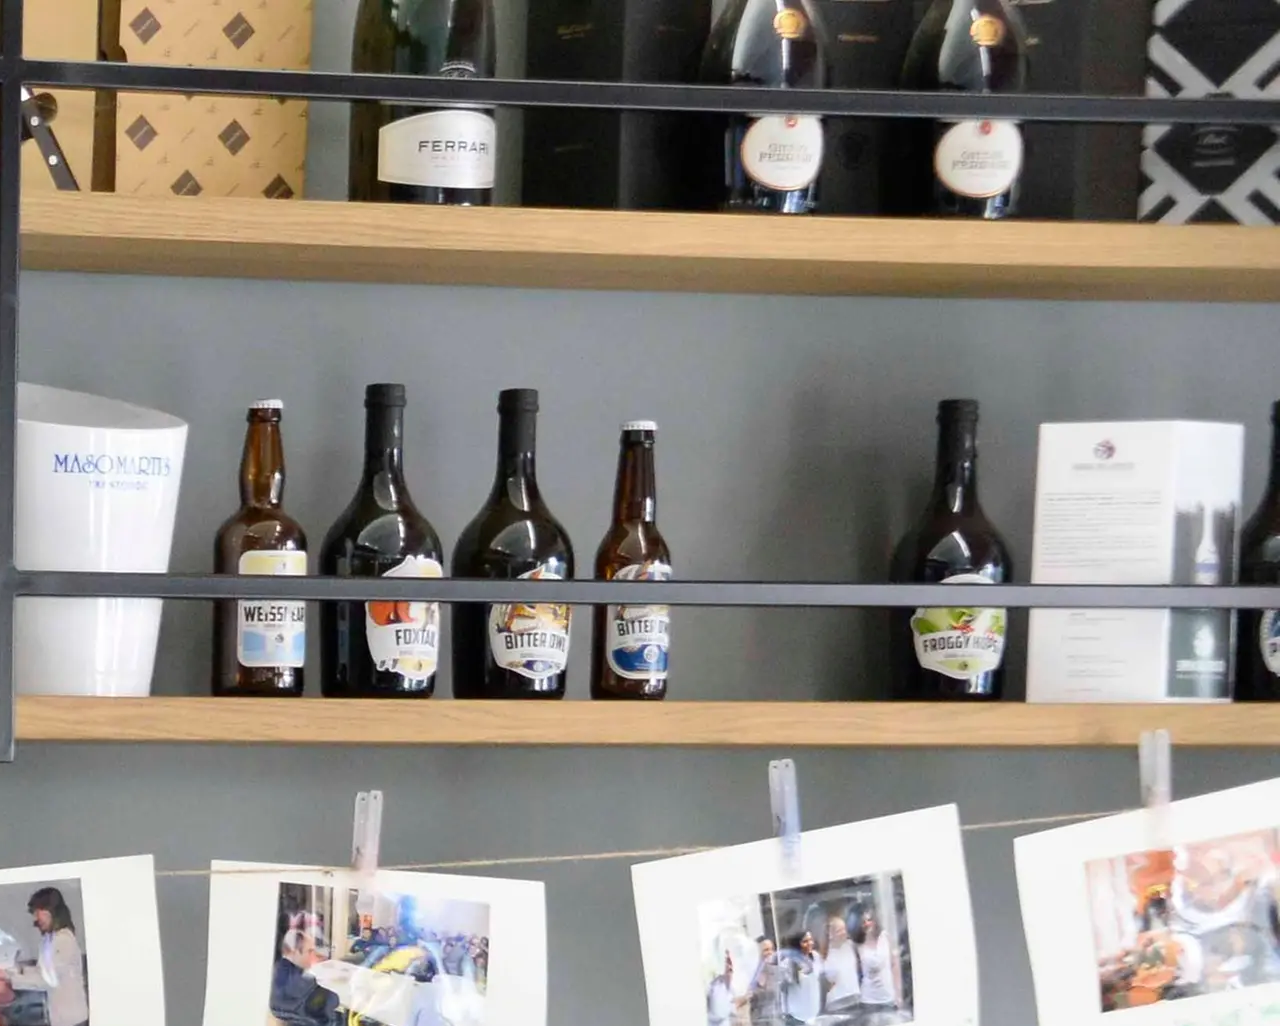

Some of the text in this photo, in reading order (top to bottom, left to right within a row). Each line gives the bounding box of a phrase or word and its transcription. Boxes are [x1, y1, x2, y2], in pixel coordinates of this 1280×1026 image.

[418, 140, 490, 155] FERRARI
[52, 453, 114, 474] MASO
[923, 635, 970, 653] FROGGY
